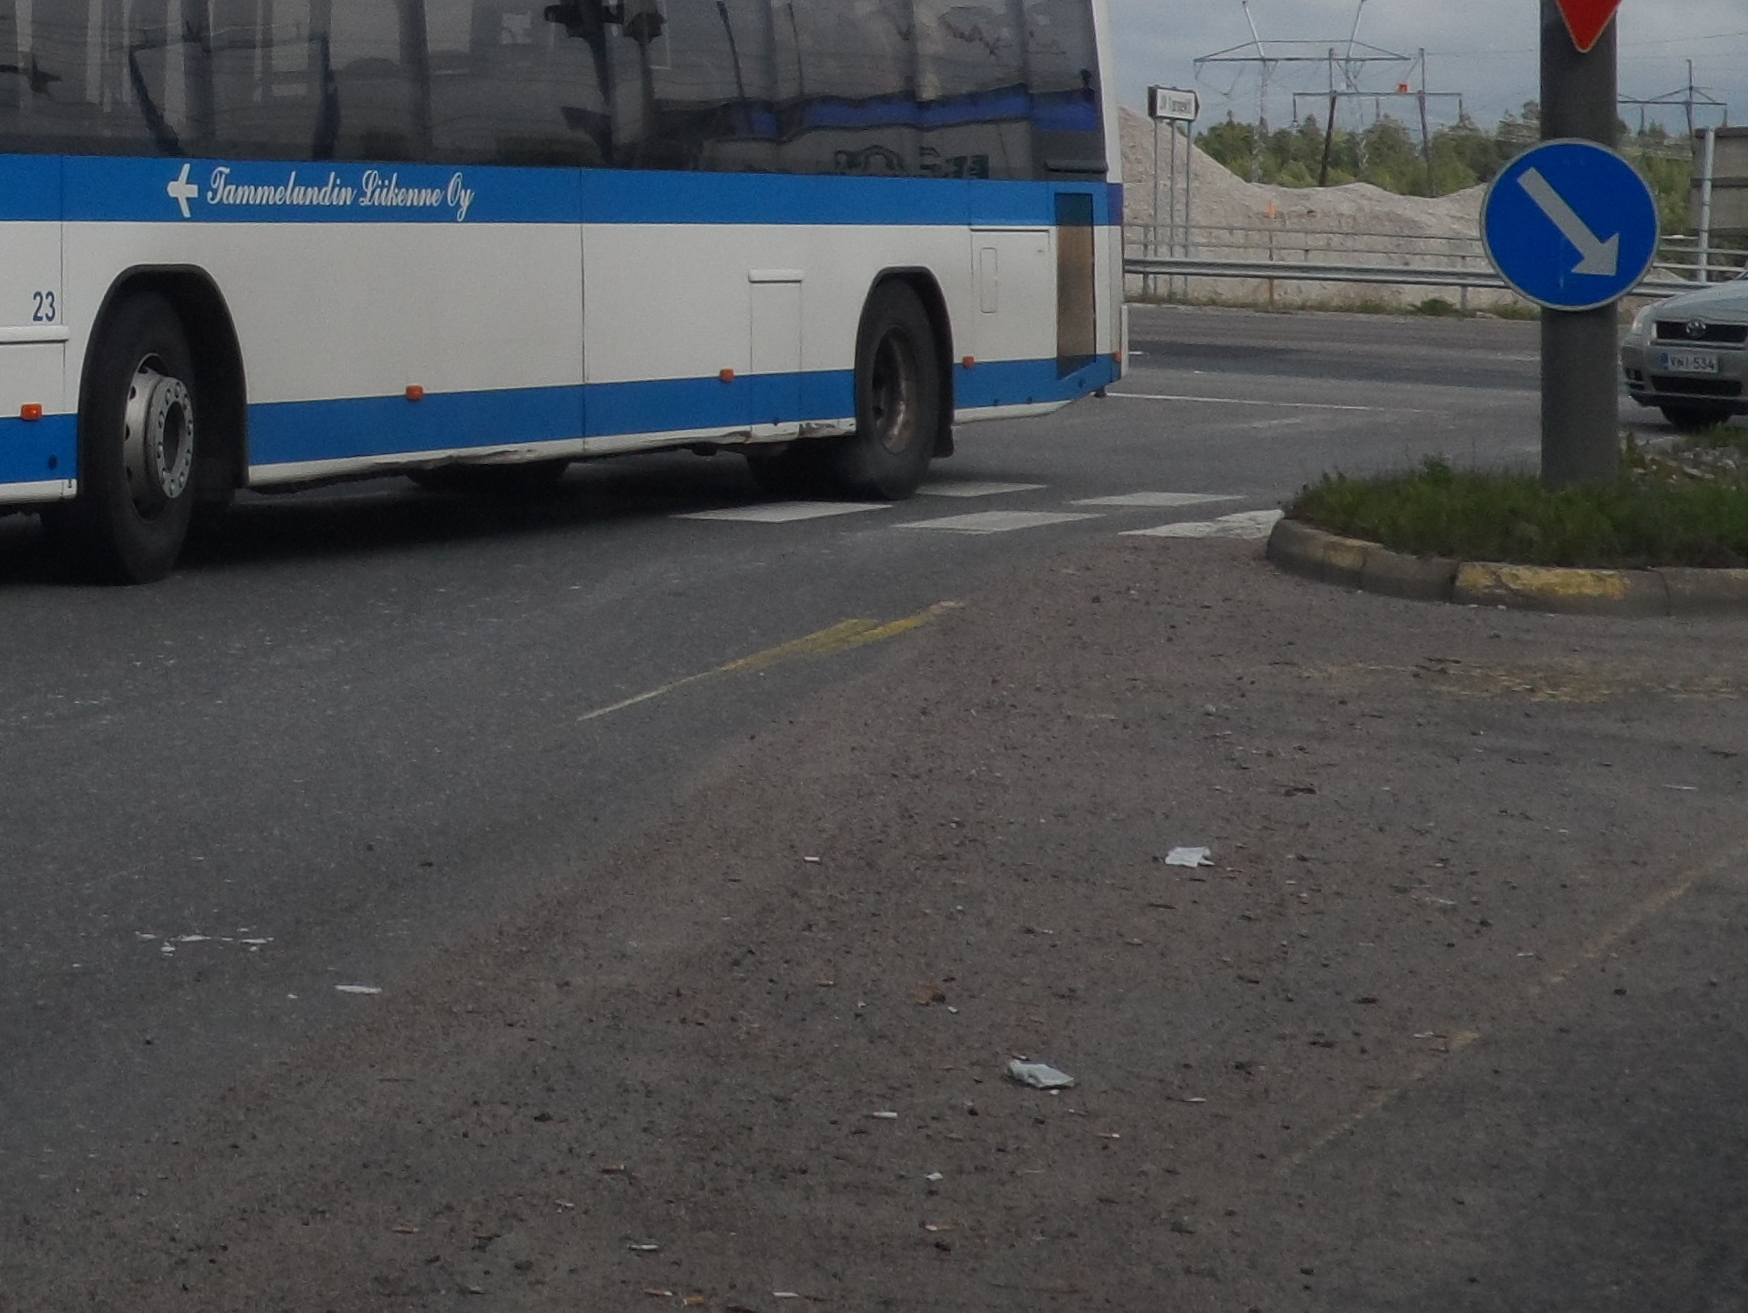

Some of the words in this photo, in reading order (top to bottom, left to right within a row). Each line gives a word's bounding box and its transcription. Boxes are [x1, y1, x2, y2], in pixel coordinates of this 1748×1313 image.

[206, 166, 356, 206] Tammelundin
[358, 169, 446, 207] Liikenne
[447, 171, 475, 222] Oy
[32, 290, 56, 322] 23
